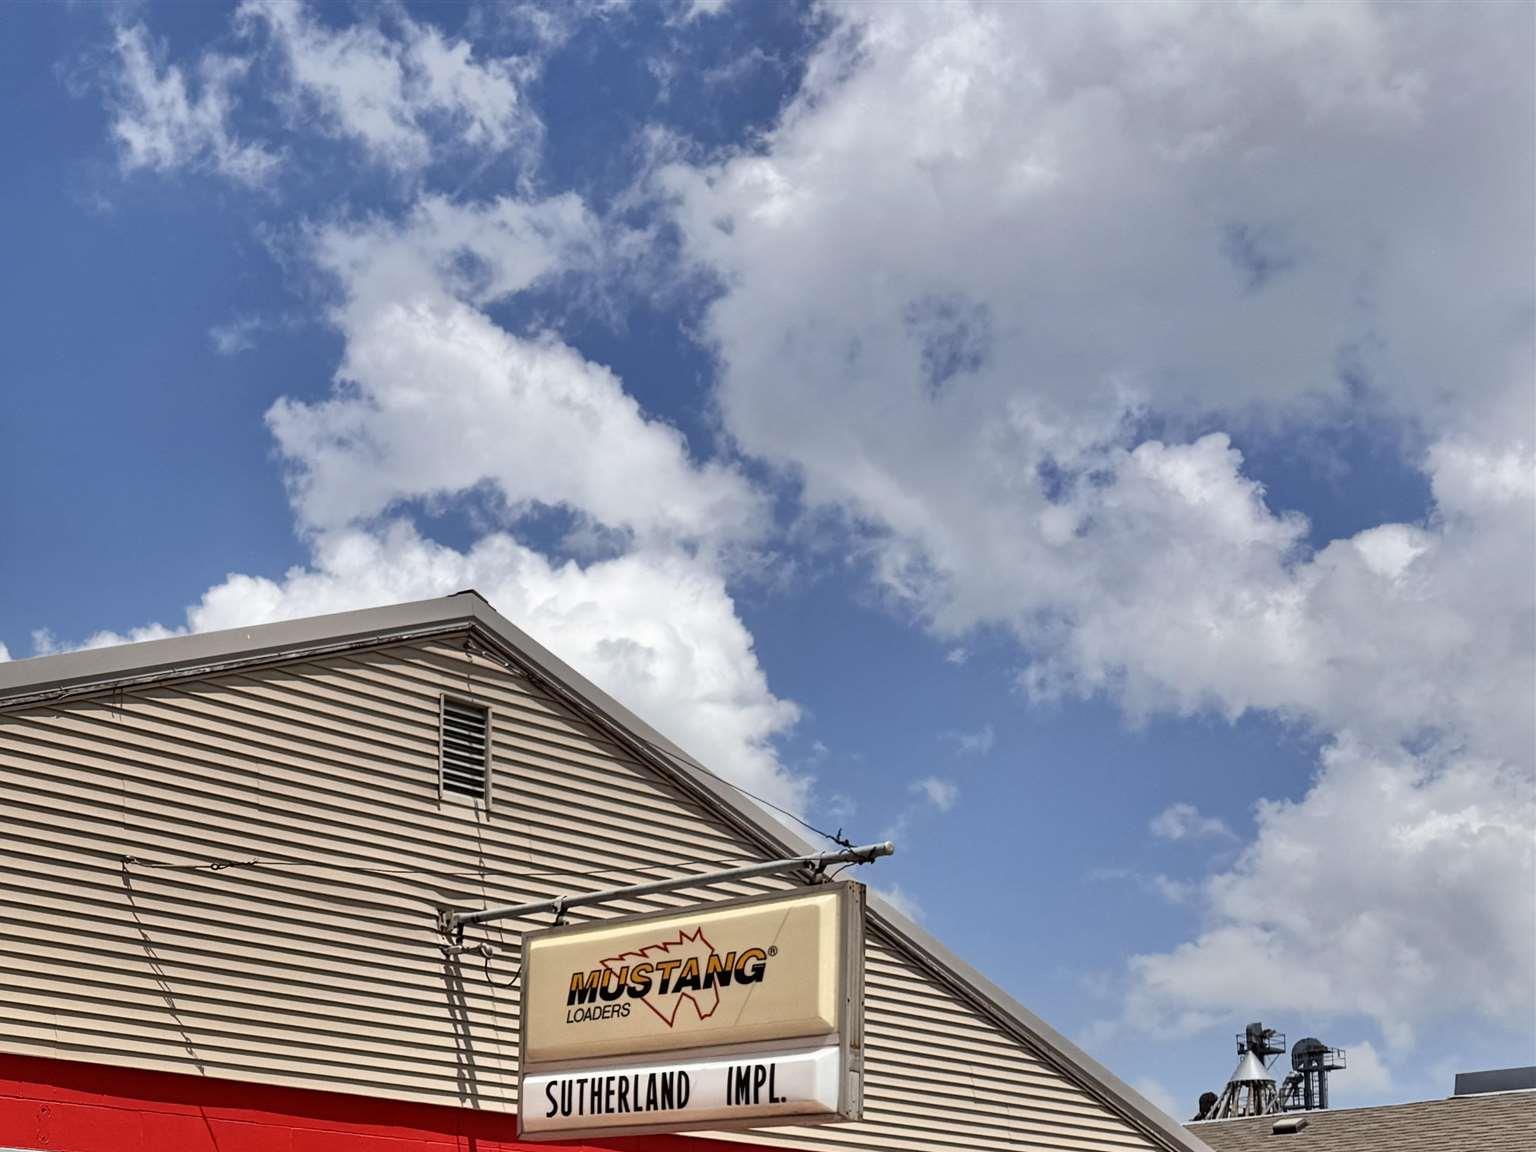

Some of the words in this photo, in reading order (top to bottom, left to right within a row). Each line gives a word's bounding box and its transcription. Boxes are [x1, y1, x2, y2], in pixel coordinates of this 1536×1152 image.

[566, 1002, 631, 1024] LOADERS
[545, 1070, 690, 1118] SUTHERLAND
[726, 1063, 787, 1106] IMPL.
